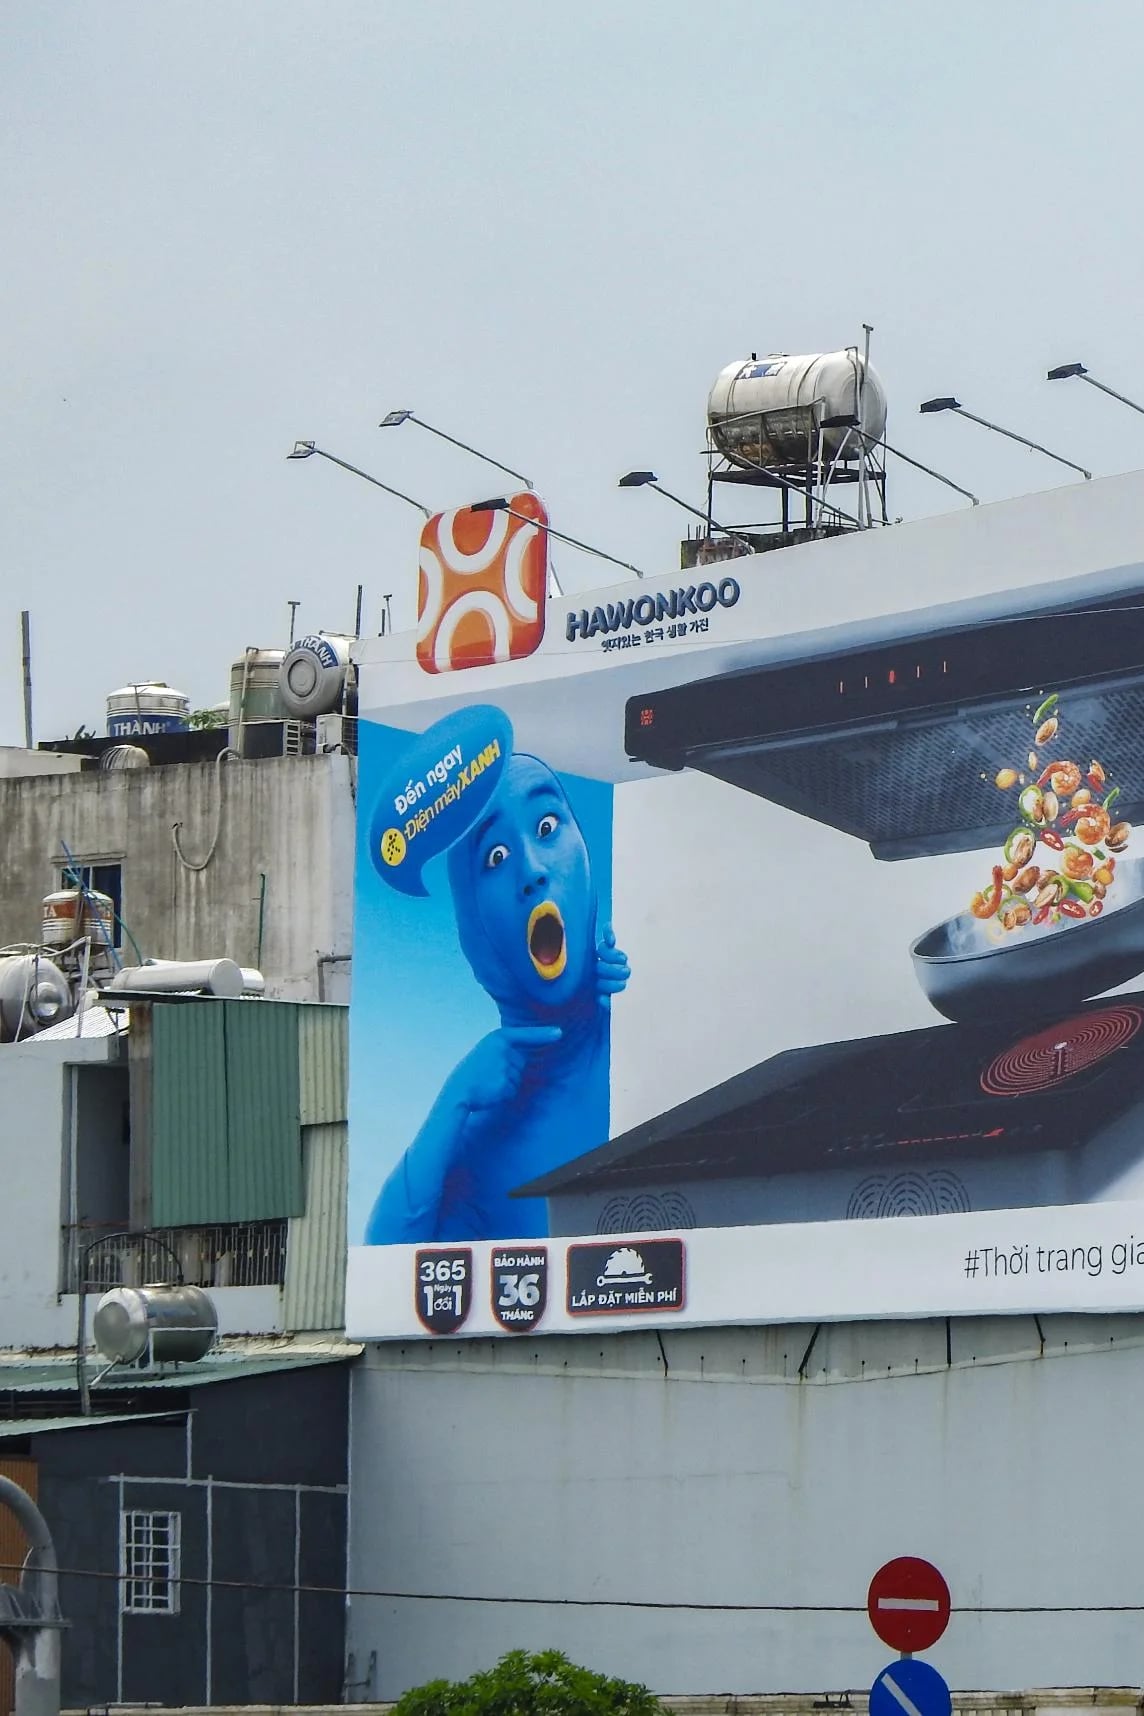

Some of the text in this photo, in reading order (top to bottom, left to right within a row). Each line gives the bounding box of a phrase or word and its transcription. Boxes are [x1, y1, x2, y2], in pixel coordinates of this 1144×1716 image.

[566, 577, 741, 642] HAWONKOO
[394, 744, 463, 815] Đến ngay
[420, 1259, 466, 1282] 365
[494, 1253, 545, 1268] BẢO HÀNH
[964, 1244, 1030, 1278] #Thời
[1036, 1245, 1103, 1277] trang
[423, 1285, 434, 1317] 1
[452, 1284, 463, 1316] 1
[498, 1273, 540, 1307] 36
[624, 1287, 655, 1304] MIỄN
[657, 1287, 678, 1303] PHÍ
[500, 1308, 534, 1321] THÁNG
